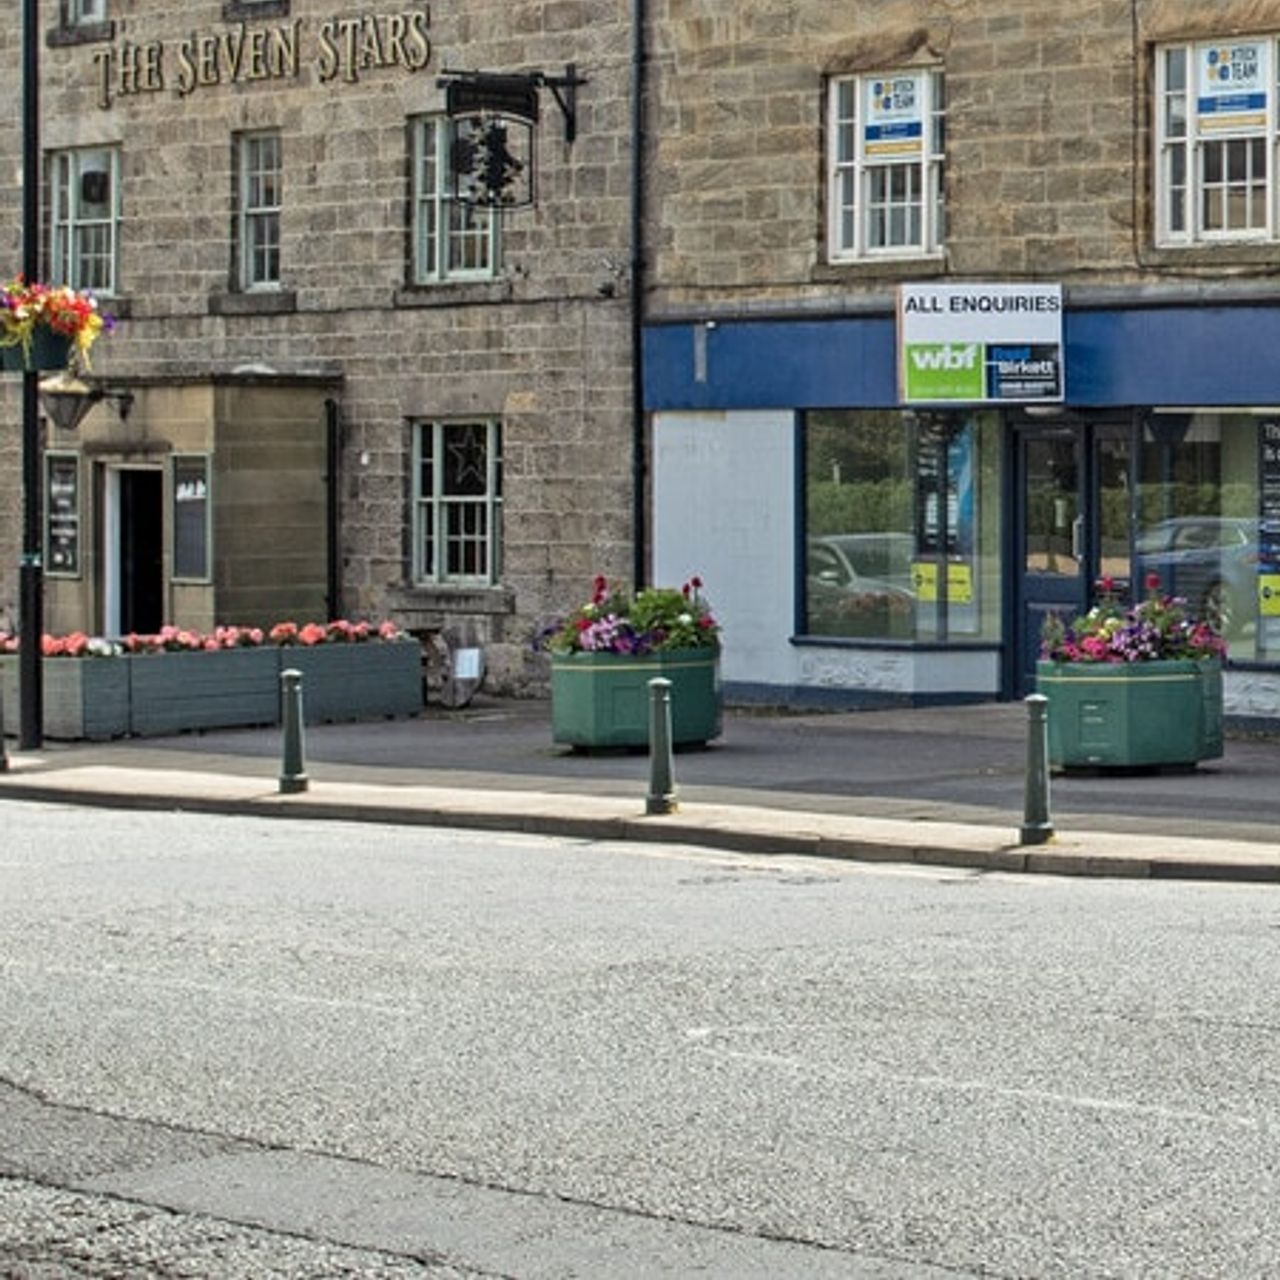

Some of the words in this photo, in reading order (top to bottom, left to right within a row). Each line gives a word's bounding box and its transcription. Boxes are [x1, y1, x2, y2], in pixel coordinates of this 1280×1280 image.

[94, 41, 163, 109] THE
[175, 18, 303, 97] SEVEN
[317, 6, 431, 83] STARS
[905, 295, 943, 313] ALL
[949, 295, 1060, 313] ENQUIRIES
